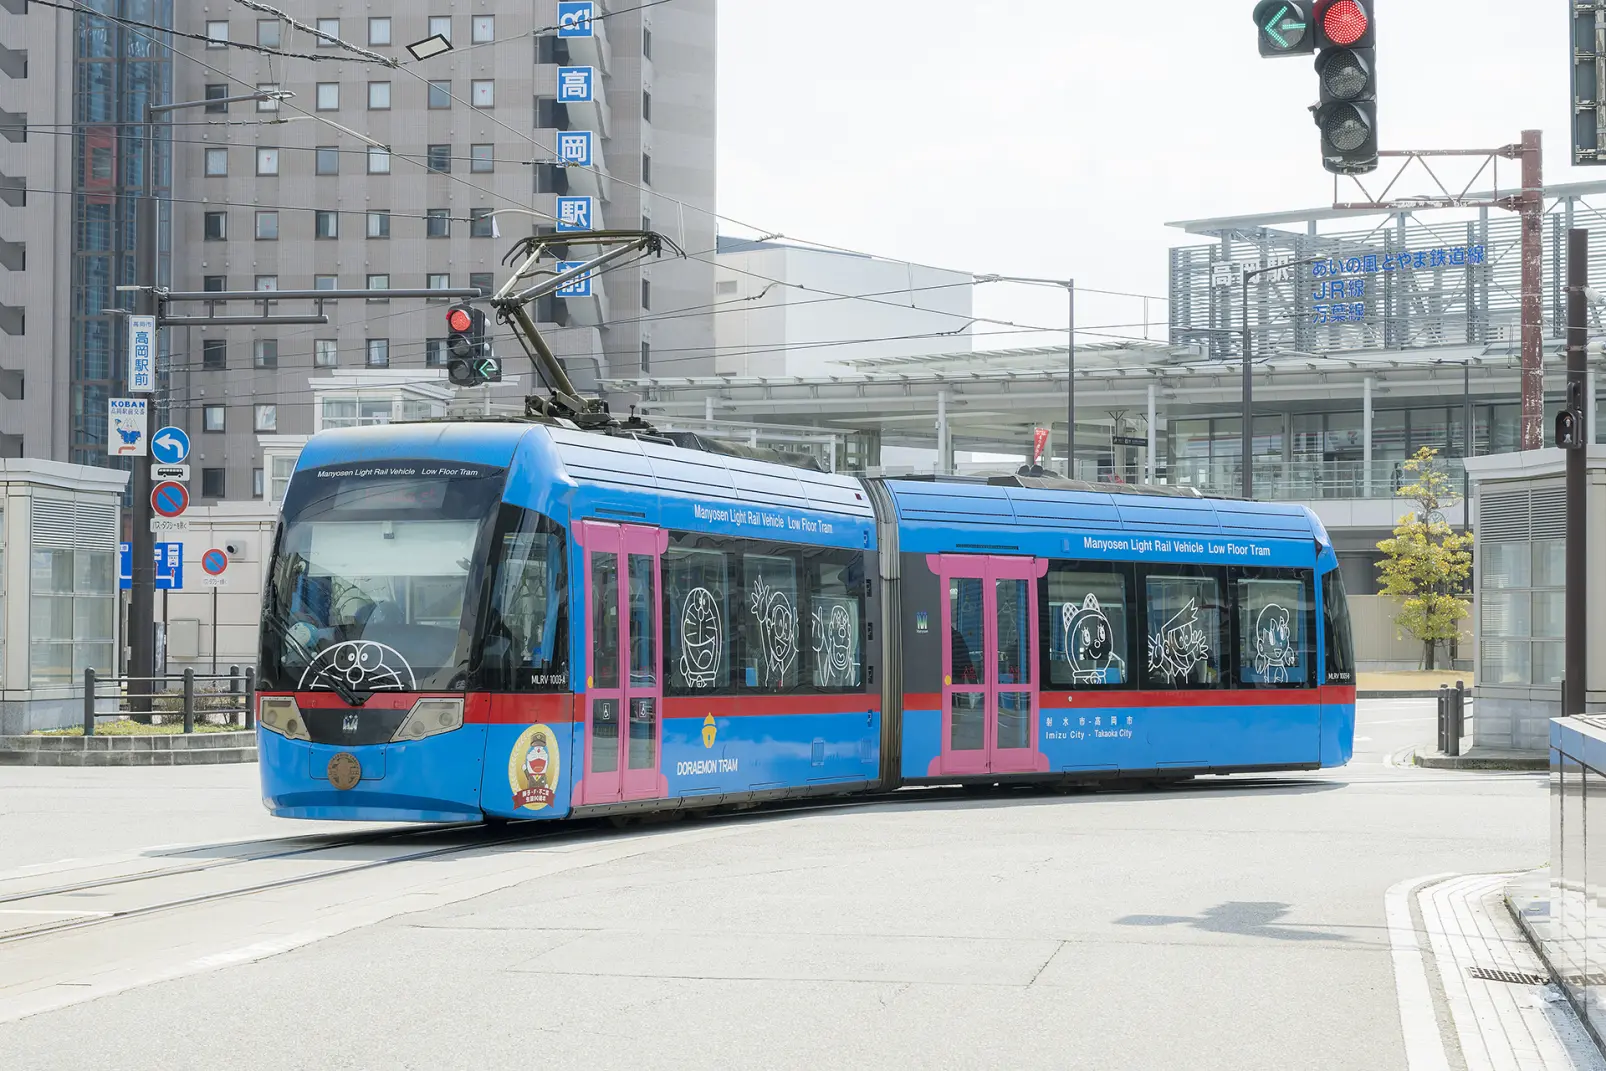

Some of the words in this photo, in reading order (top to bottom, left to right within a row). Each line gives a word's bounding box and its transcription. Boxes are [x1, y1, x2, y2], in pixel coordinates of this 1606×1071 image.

[1312, 246, 1485, 277] あいの風とやま鉄道線
[1312, 278, 1365, 301] JR線
[1312, 302, 1365, 324] 万葉線
[135, 331, 149, 386] 高岡駅前
[111, 400, 145, 408] KOBAN
[317, 470, 353, 479] Manyosen
[354, 468, 373, 477] Light
[438, 468, 459, 476] Floor
[459, 468, 479, 476] Tram
[694, 504, 729, 523] Manyosen
[730, 508, 747, 527] Light
[748, 511, 761, 526] Rail
[761, 512, 785, 529] Vehicle
[787, 515, 801, 530] Low
[801, 517, 818, 532] Floor
[818, 519, 833, 534] Tram
[1083, 537, 1129, 551] Manyosen
[1131, 539, 1153, 554] Light
[1154, 540, 1171, 552] Rail
[1173, 541, 1204, 553] Vehicle
[1208, 543, 1225, 554] Low
[1227, 544, 1249, 555] Floor
[1249, 545, 1271, 556] Tram
[531, 674, 549, 685] MLRV
[1045, 731, 1067, 740] Imizu
[1070, 730, 1085, 741] City
[1094, 729, 1119, 738] Takaoka
[1119, 728, 1133, 739] City
[677, 760, 718, 776] DORAEMON
[718, 758, 739, 773] TRAM
